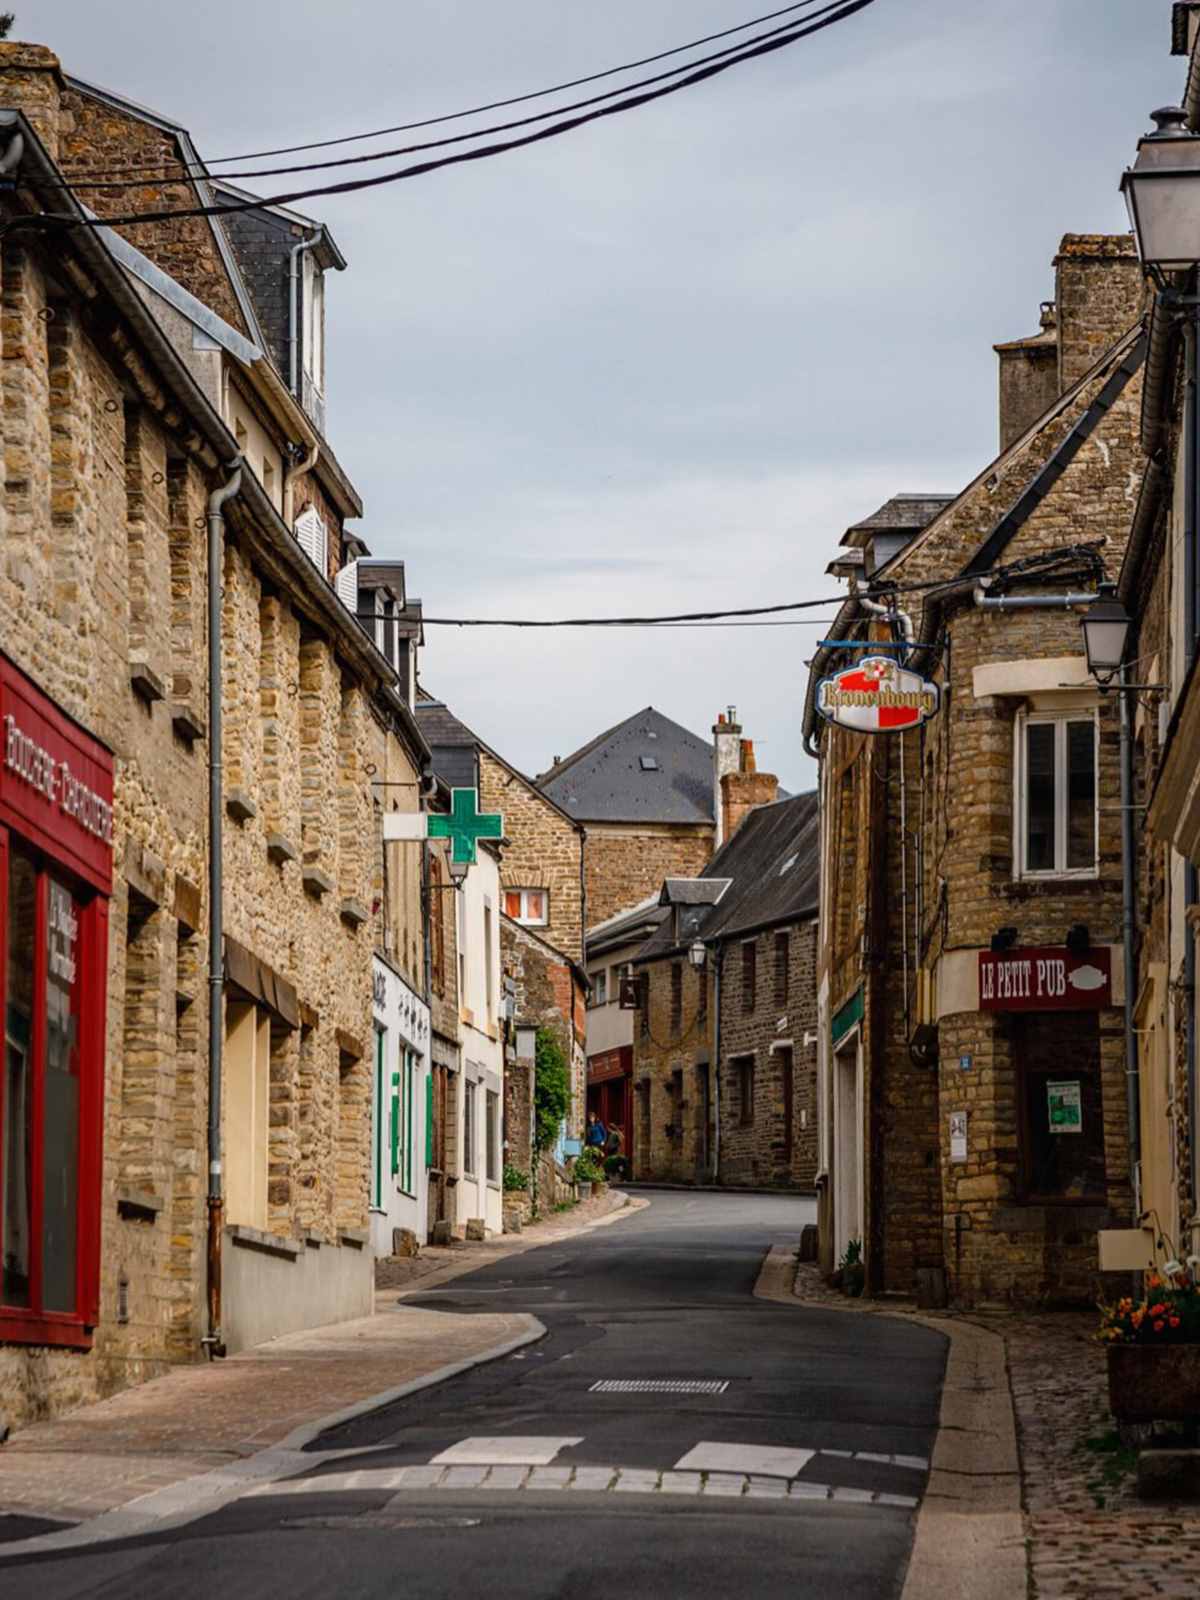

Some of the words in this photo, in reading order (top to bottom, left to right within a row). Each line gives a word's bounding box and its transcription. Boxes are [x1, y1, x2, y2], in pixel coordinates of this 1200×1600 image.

[824, 683, 935, 714] Kronenbourg
[982, 962, 994, 999] LE
[997, 960, 1031, 998] PETIT
[1036, 959, 1066, 997] PUB
